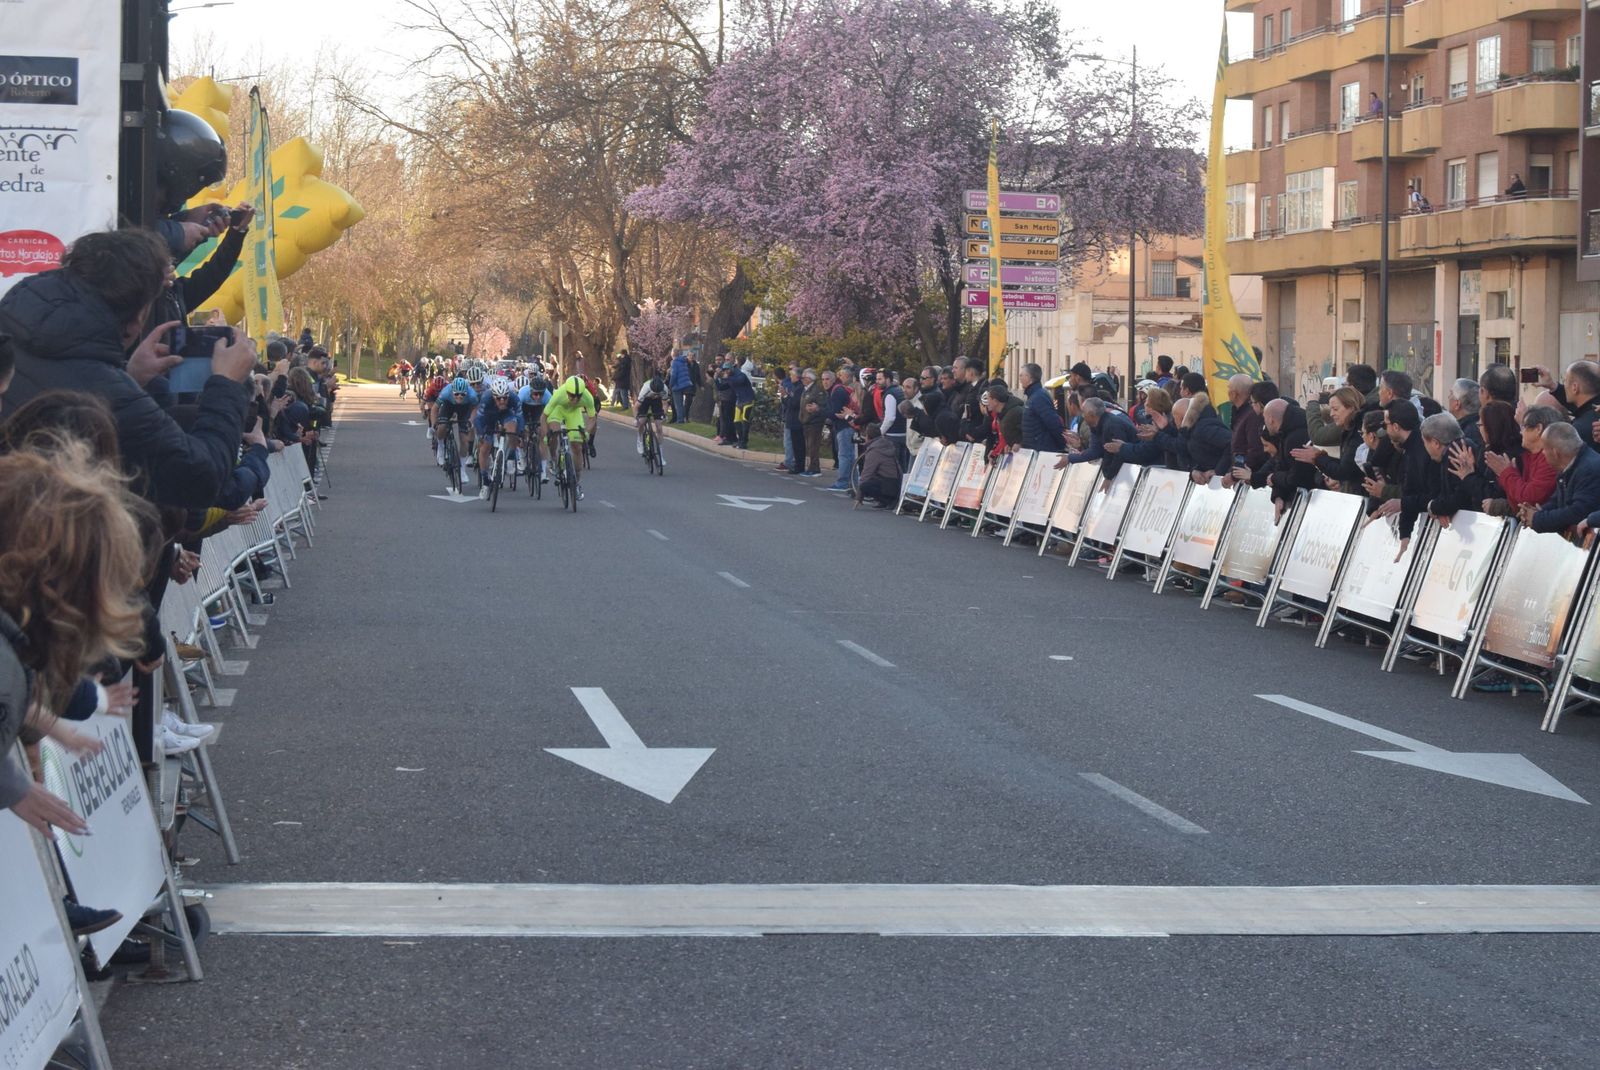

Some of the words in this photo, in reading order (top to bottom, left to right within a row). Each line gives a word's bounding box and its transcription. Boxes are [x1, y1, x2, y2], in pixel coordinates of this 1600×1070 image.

[10, 72, 72, 87] ÓPTICO
[30, 164, 45, 175] de
[0, 942, 40, 1037] ORALEJO
